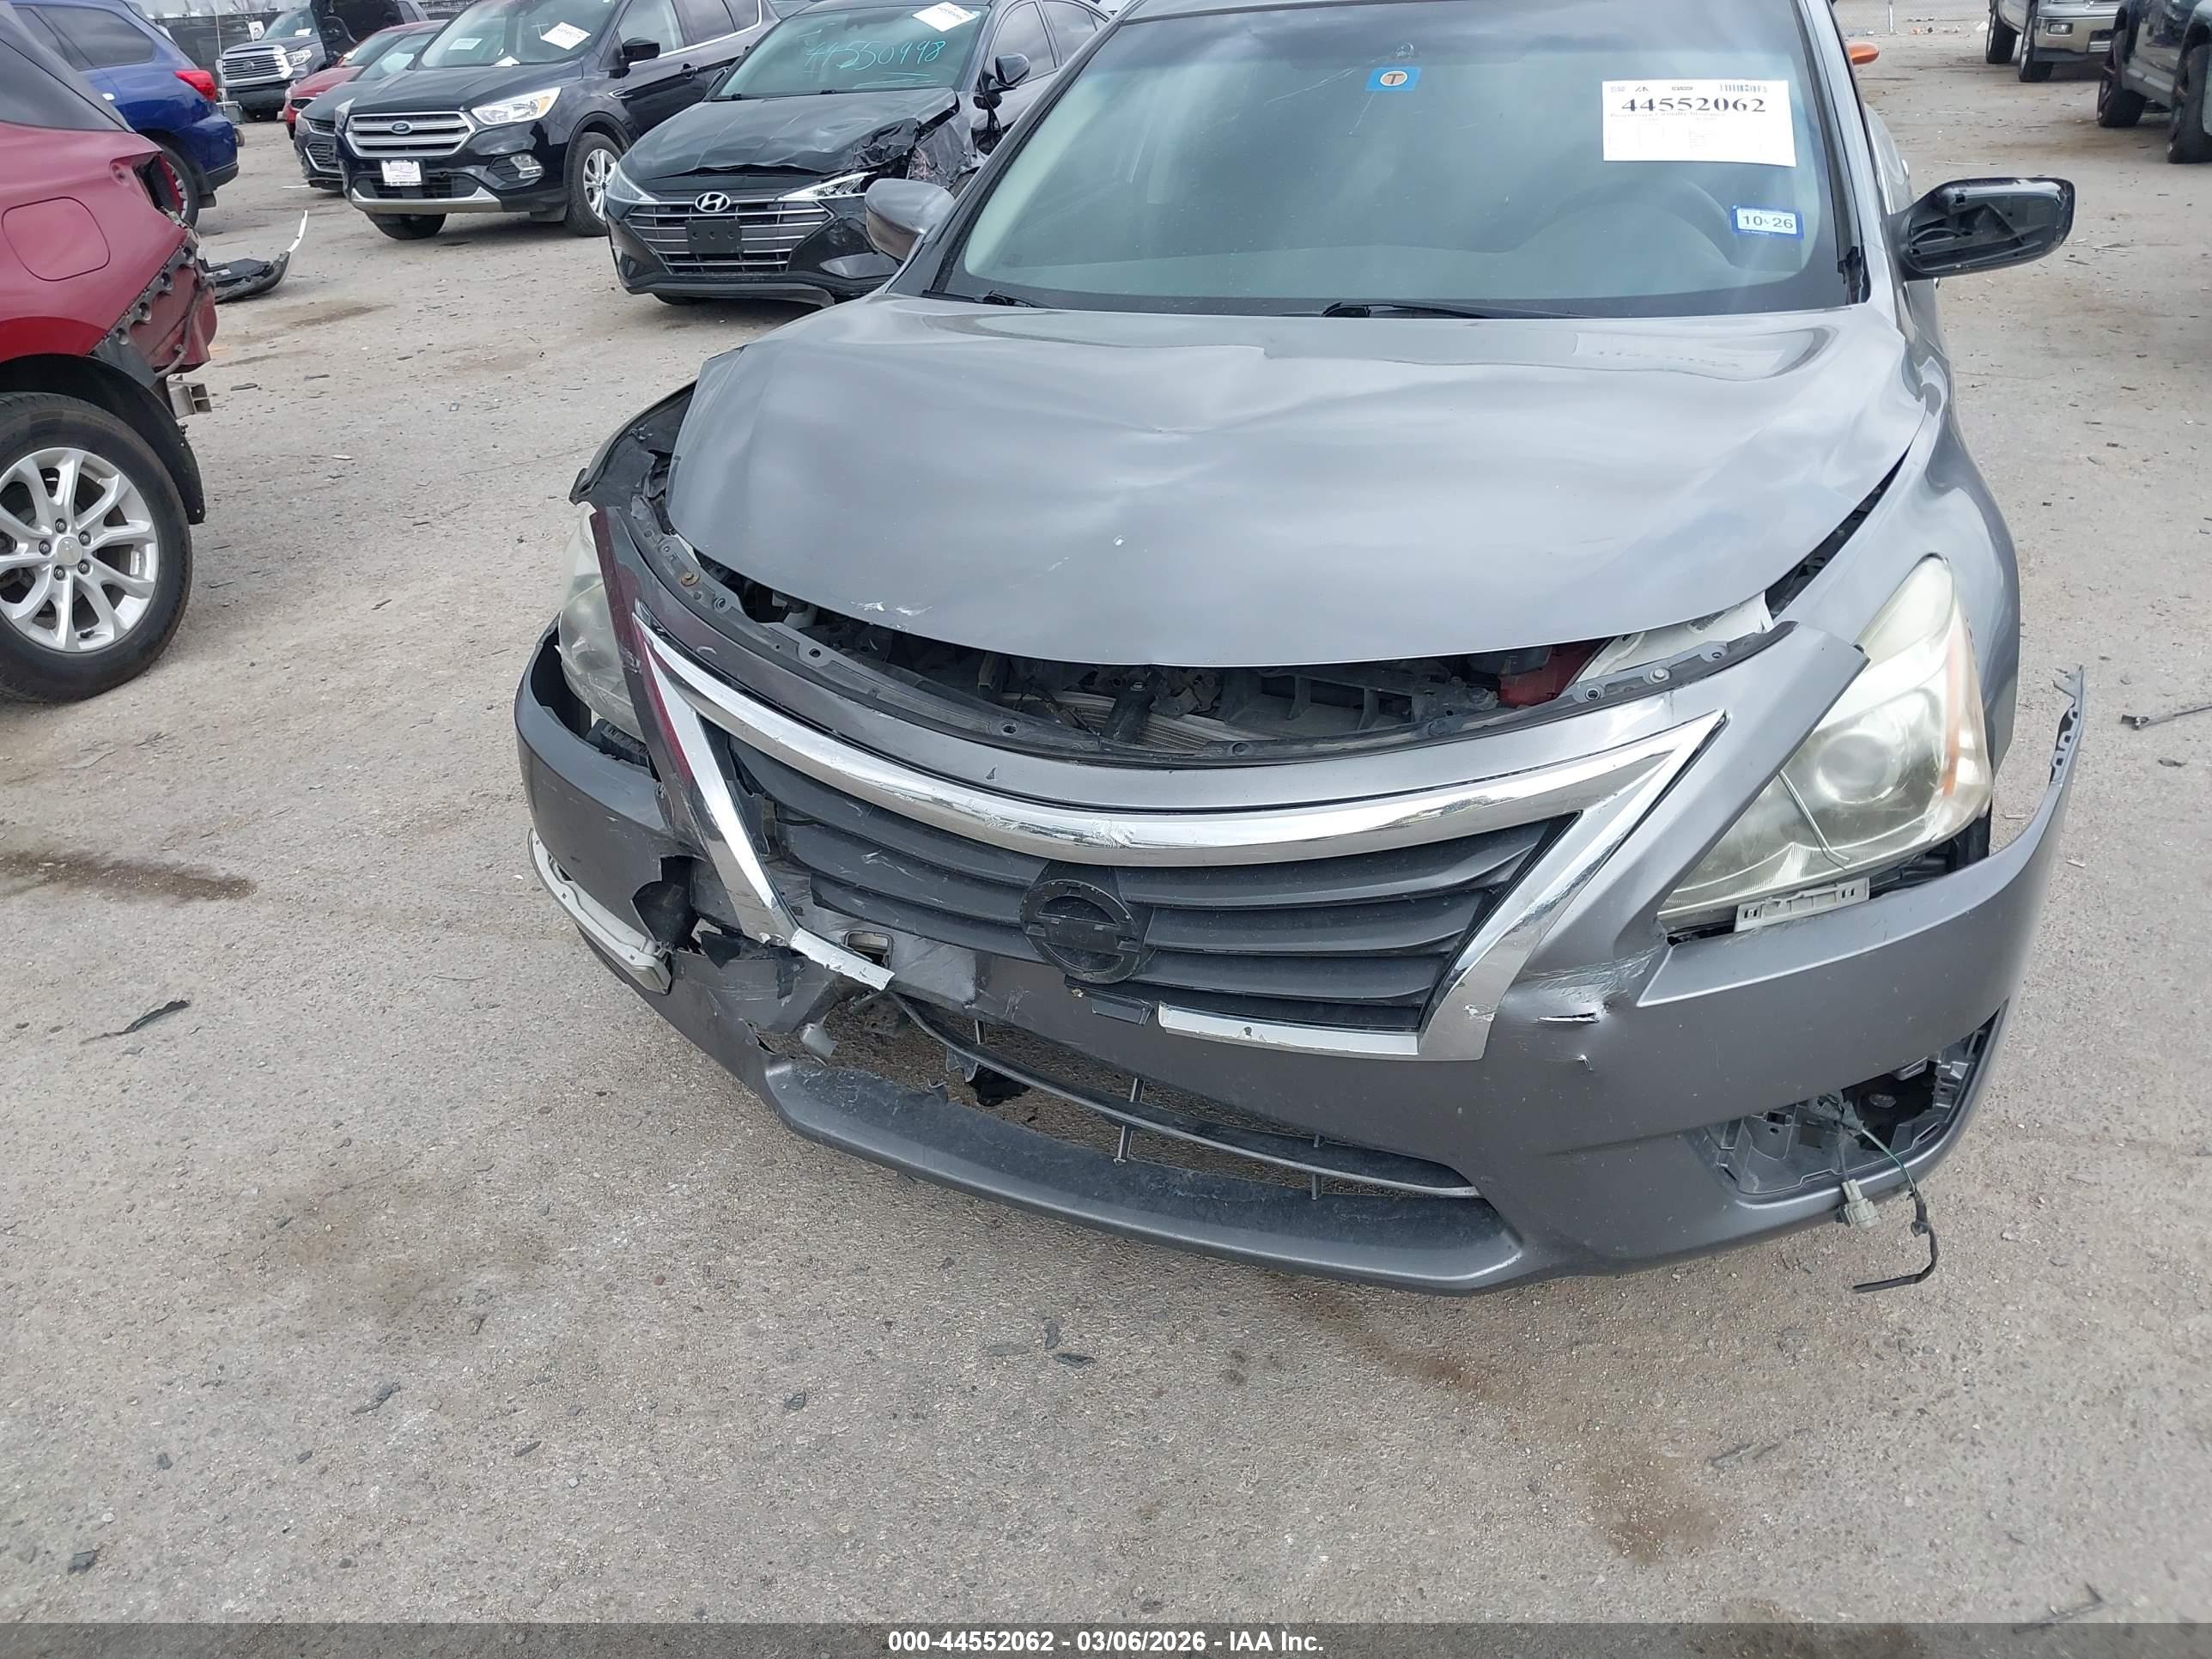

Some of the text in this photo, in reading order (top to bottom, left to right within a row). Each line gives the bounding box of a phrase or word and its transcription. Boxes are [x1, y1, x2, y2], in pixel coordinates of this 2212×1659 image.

[1387, 73, 1405, 85] T
[1621, 96, 1766, 112] 44552062
[1742, 215, 1794, 229] 10 26
